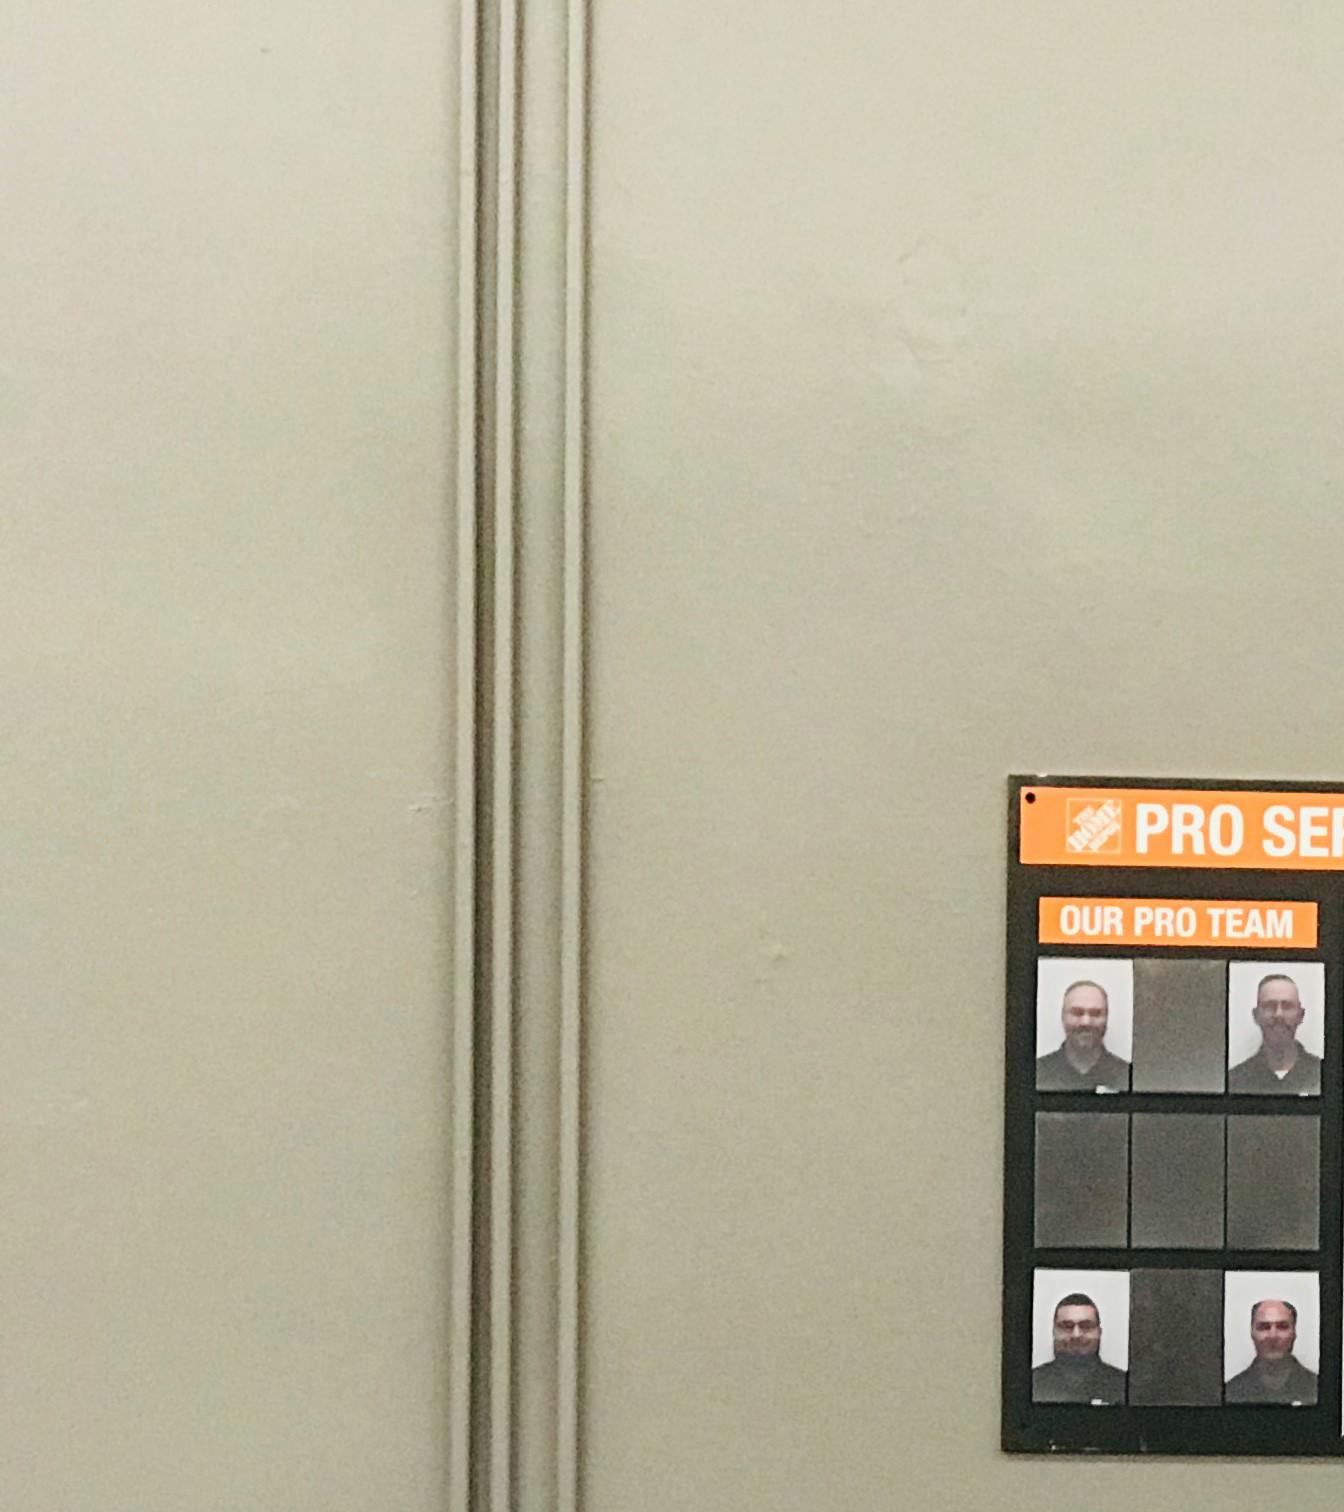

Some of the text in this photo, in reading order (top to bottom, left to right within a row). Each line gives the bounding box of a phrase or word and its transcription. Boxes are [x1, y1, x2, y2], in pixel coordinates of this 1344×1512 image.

[1136, 803, 1244, 857] PRO
[1060, 905, 1293, 939] OUR PRO TEAM
